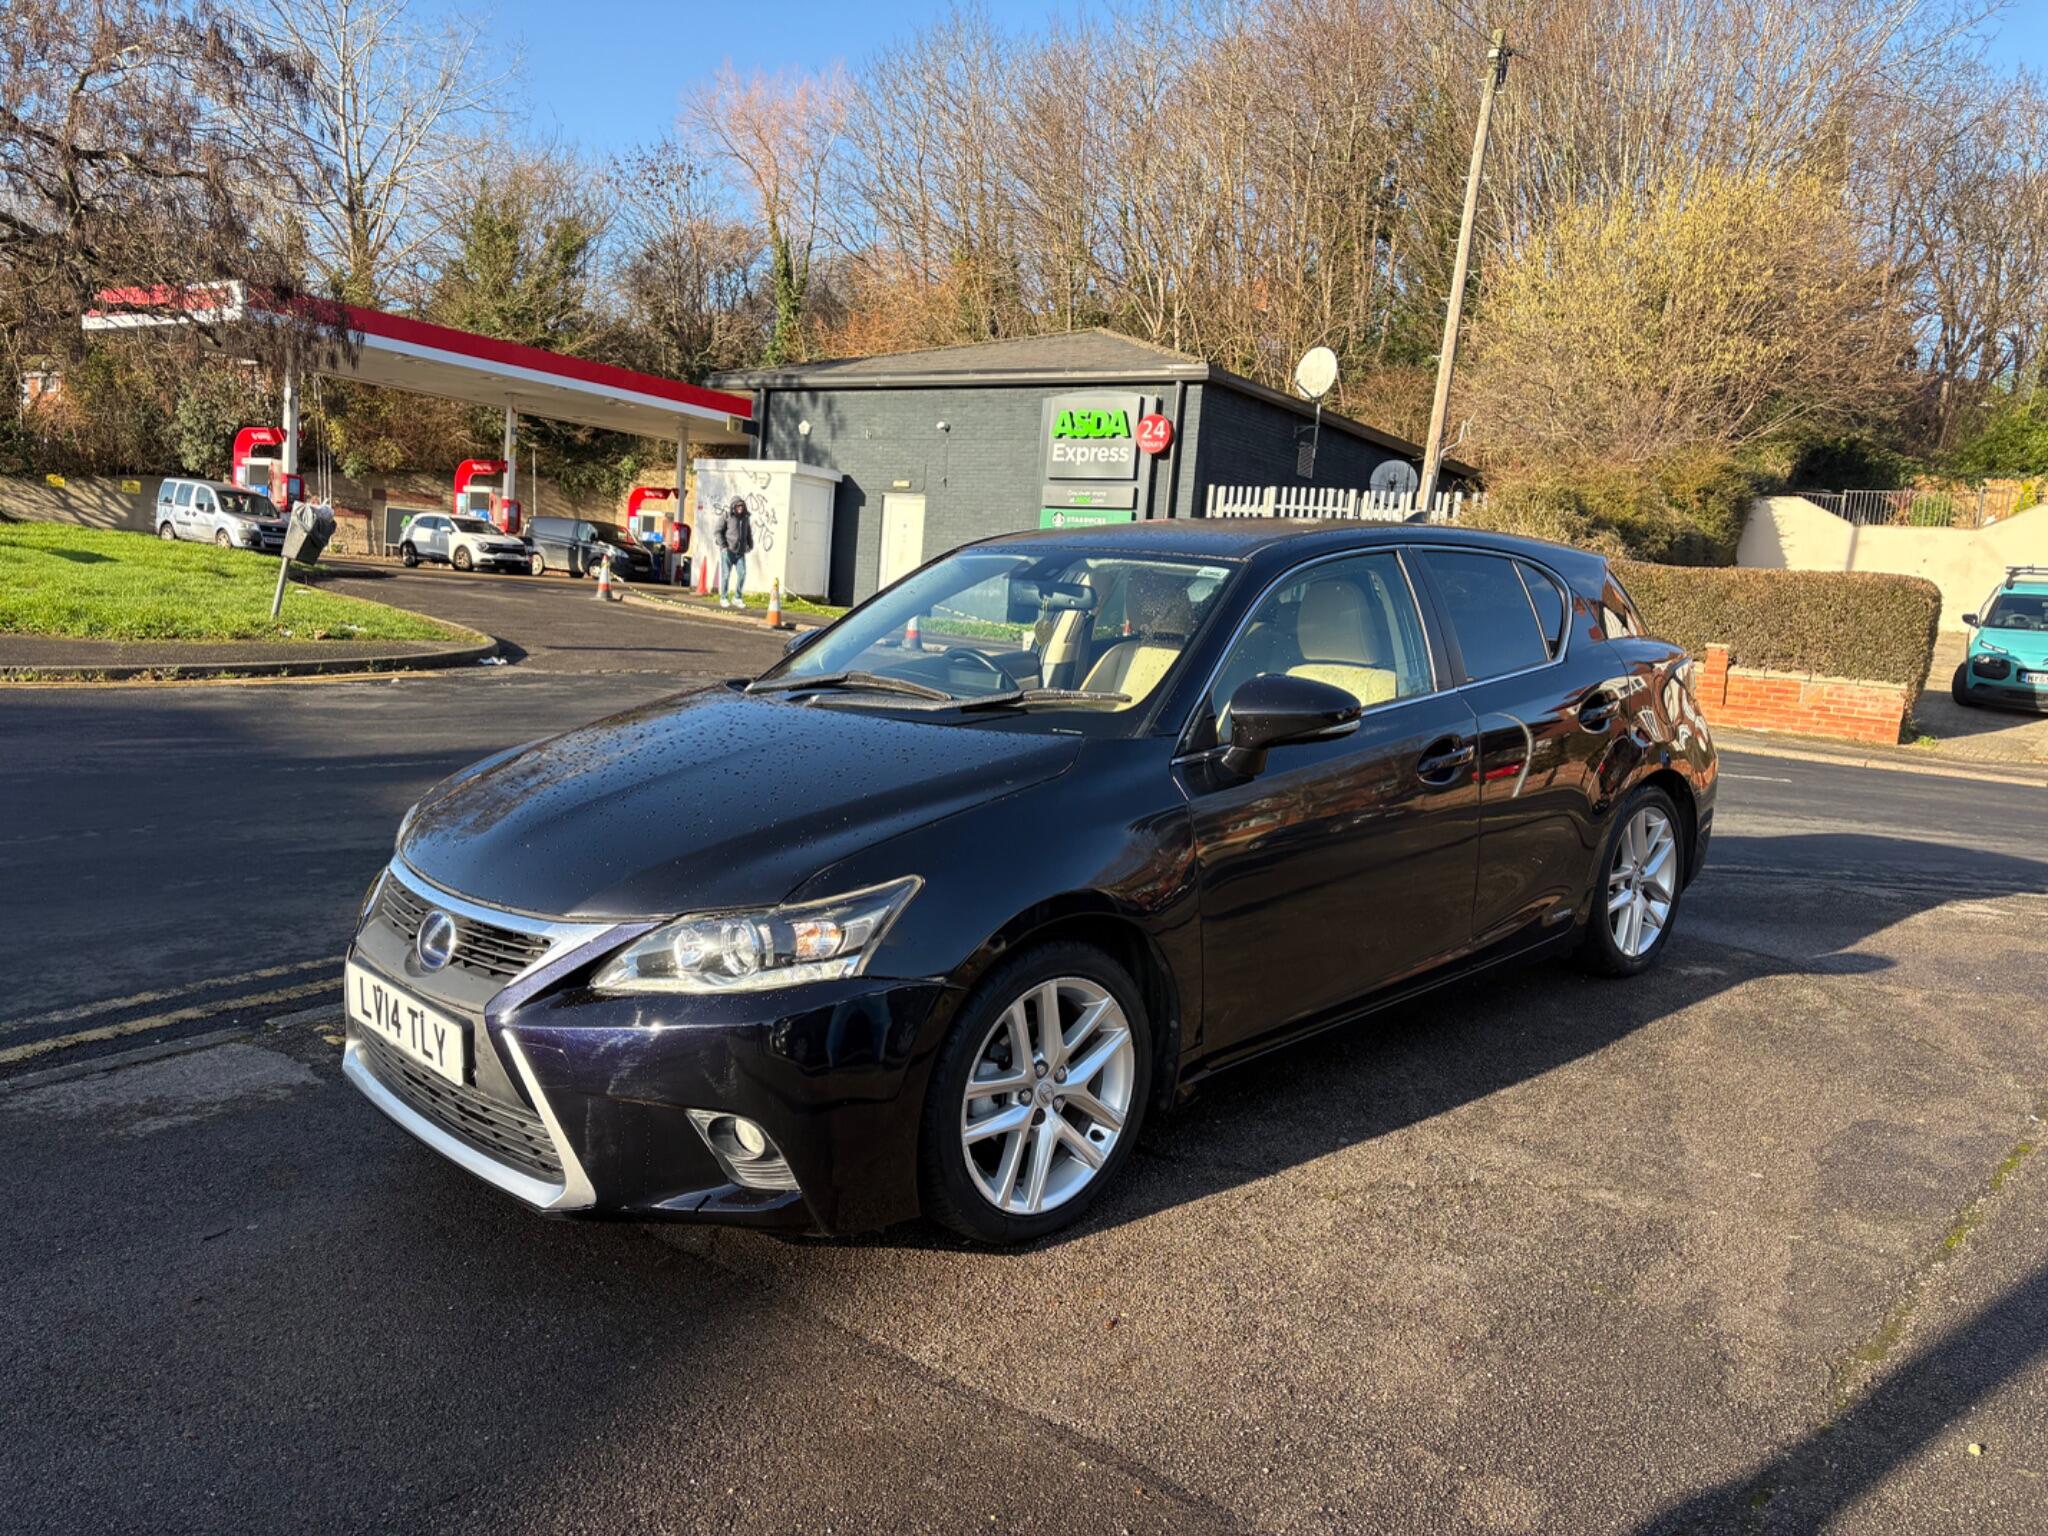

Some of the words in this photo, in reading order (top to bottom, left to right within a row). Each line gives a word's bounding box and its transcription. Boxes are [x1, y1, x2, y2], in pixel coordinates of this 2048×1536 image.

[1053, 410, 1129, 438] ASDA
[1141, 420, 1166, 438] 24
[1052, 443, 1129, 465] Express
[360, 976, 402, 1039] LV14
[407, 1006, 446, 1067] TLY
